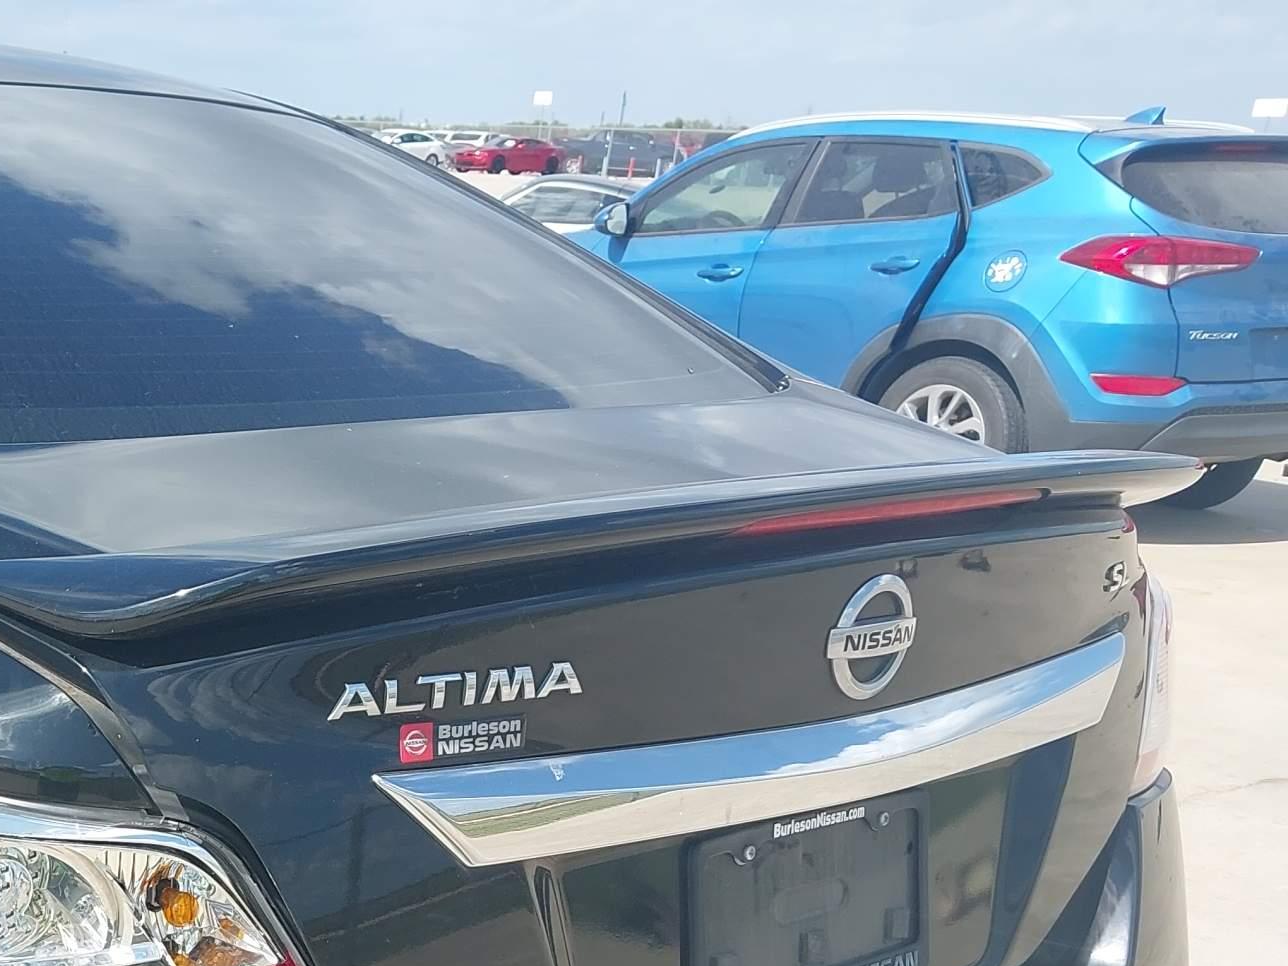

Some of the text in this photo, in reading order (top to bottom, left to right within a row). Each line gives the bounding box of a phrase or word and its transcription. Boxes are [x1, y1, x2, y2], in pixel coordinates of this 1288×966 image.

[843, 624, 914, 652] NISSAN
[327, 661, 583, 721] ALTIMA
[438, 718, 521, 739] Burleson
[438, 732, 521, 756] NISSAN
[774, 806, 865, 838] BurlesonNissan.com
